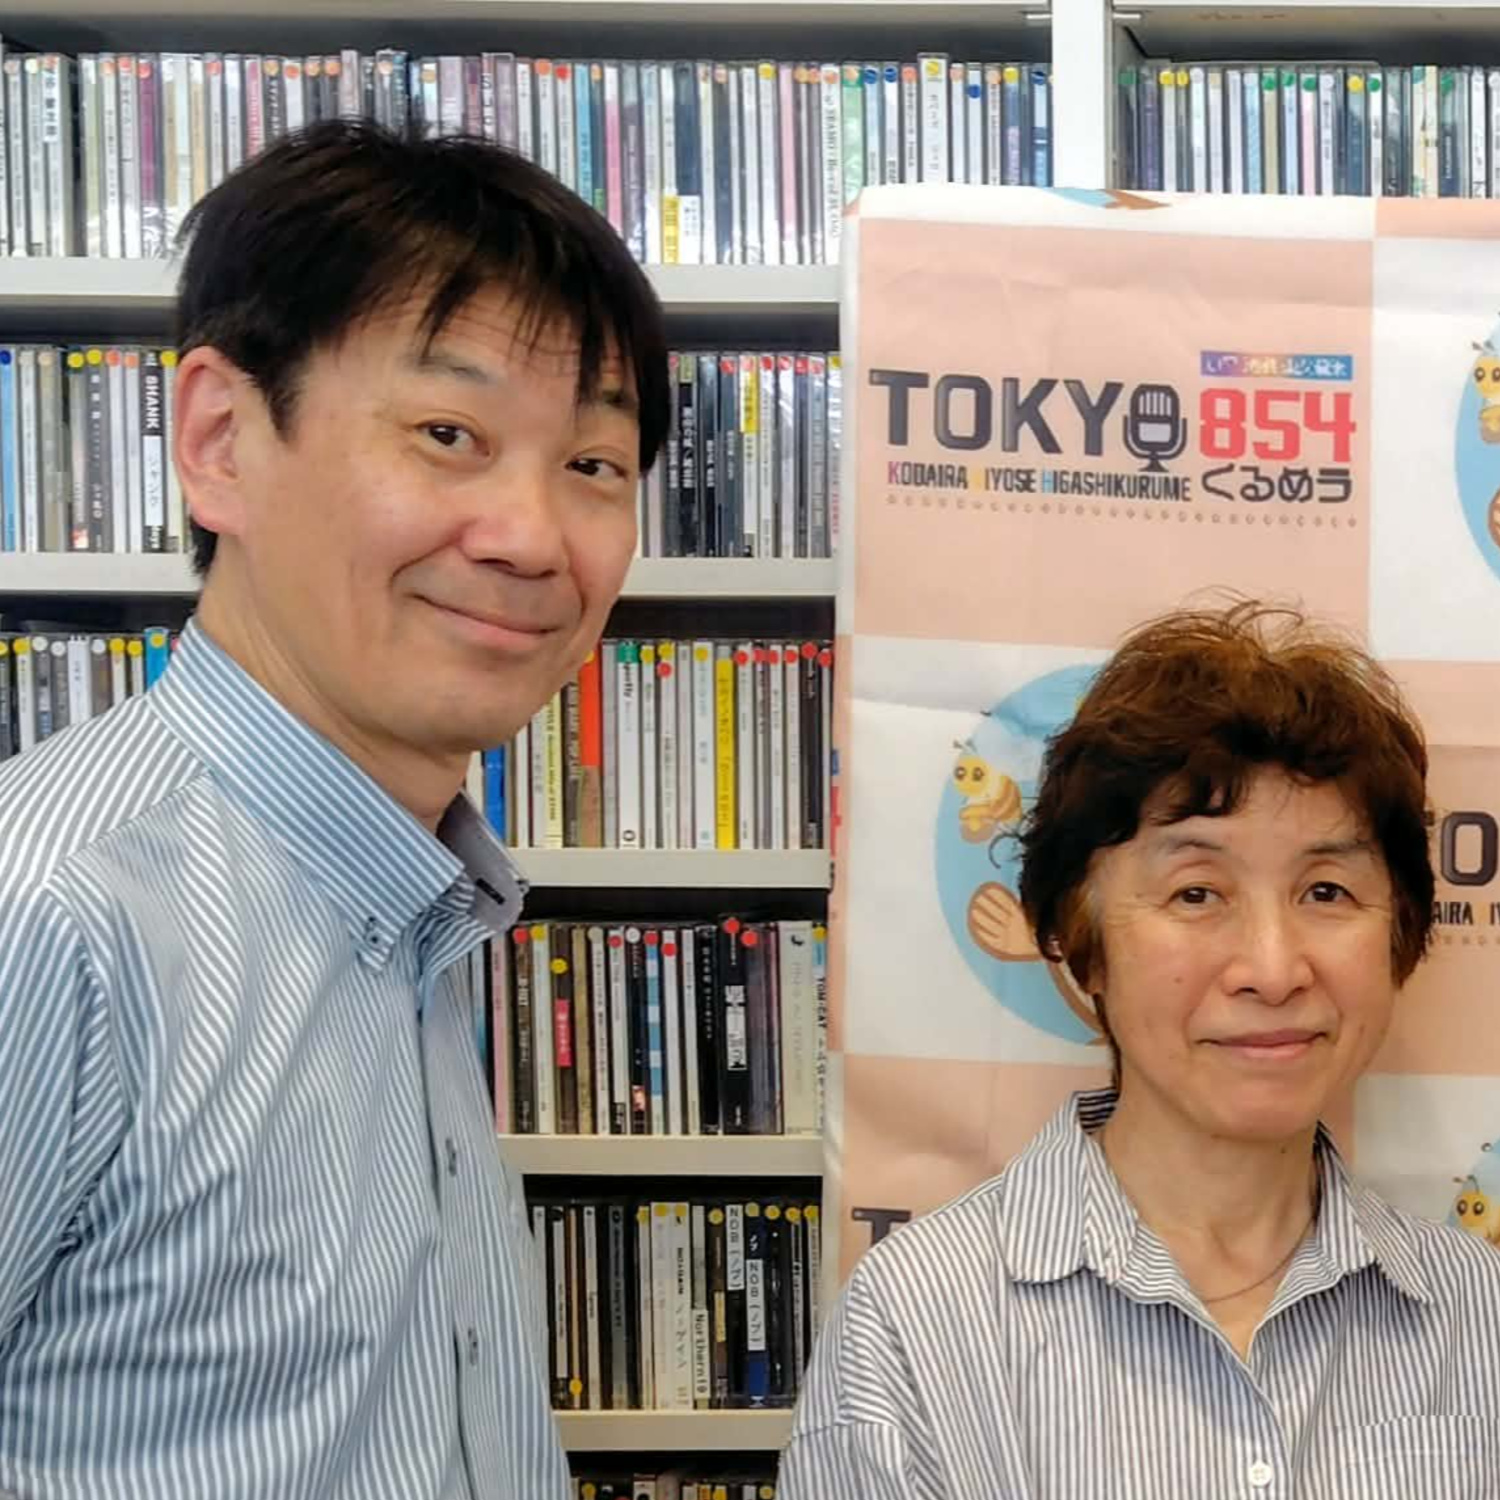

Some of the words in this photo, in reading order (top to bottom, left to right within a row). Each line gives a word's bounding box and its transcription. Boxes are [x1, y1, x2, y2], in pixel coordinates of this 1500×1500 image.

[1200, 387, 1357, 462] 854
[888, 461, 968, 491] KODAIRA
[1041, 467, 1191, 502] HIGASHIKURUME
